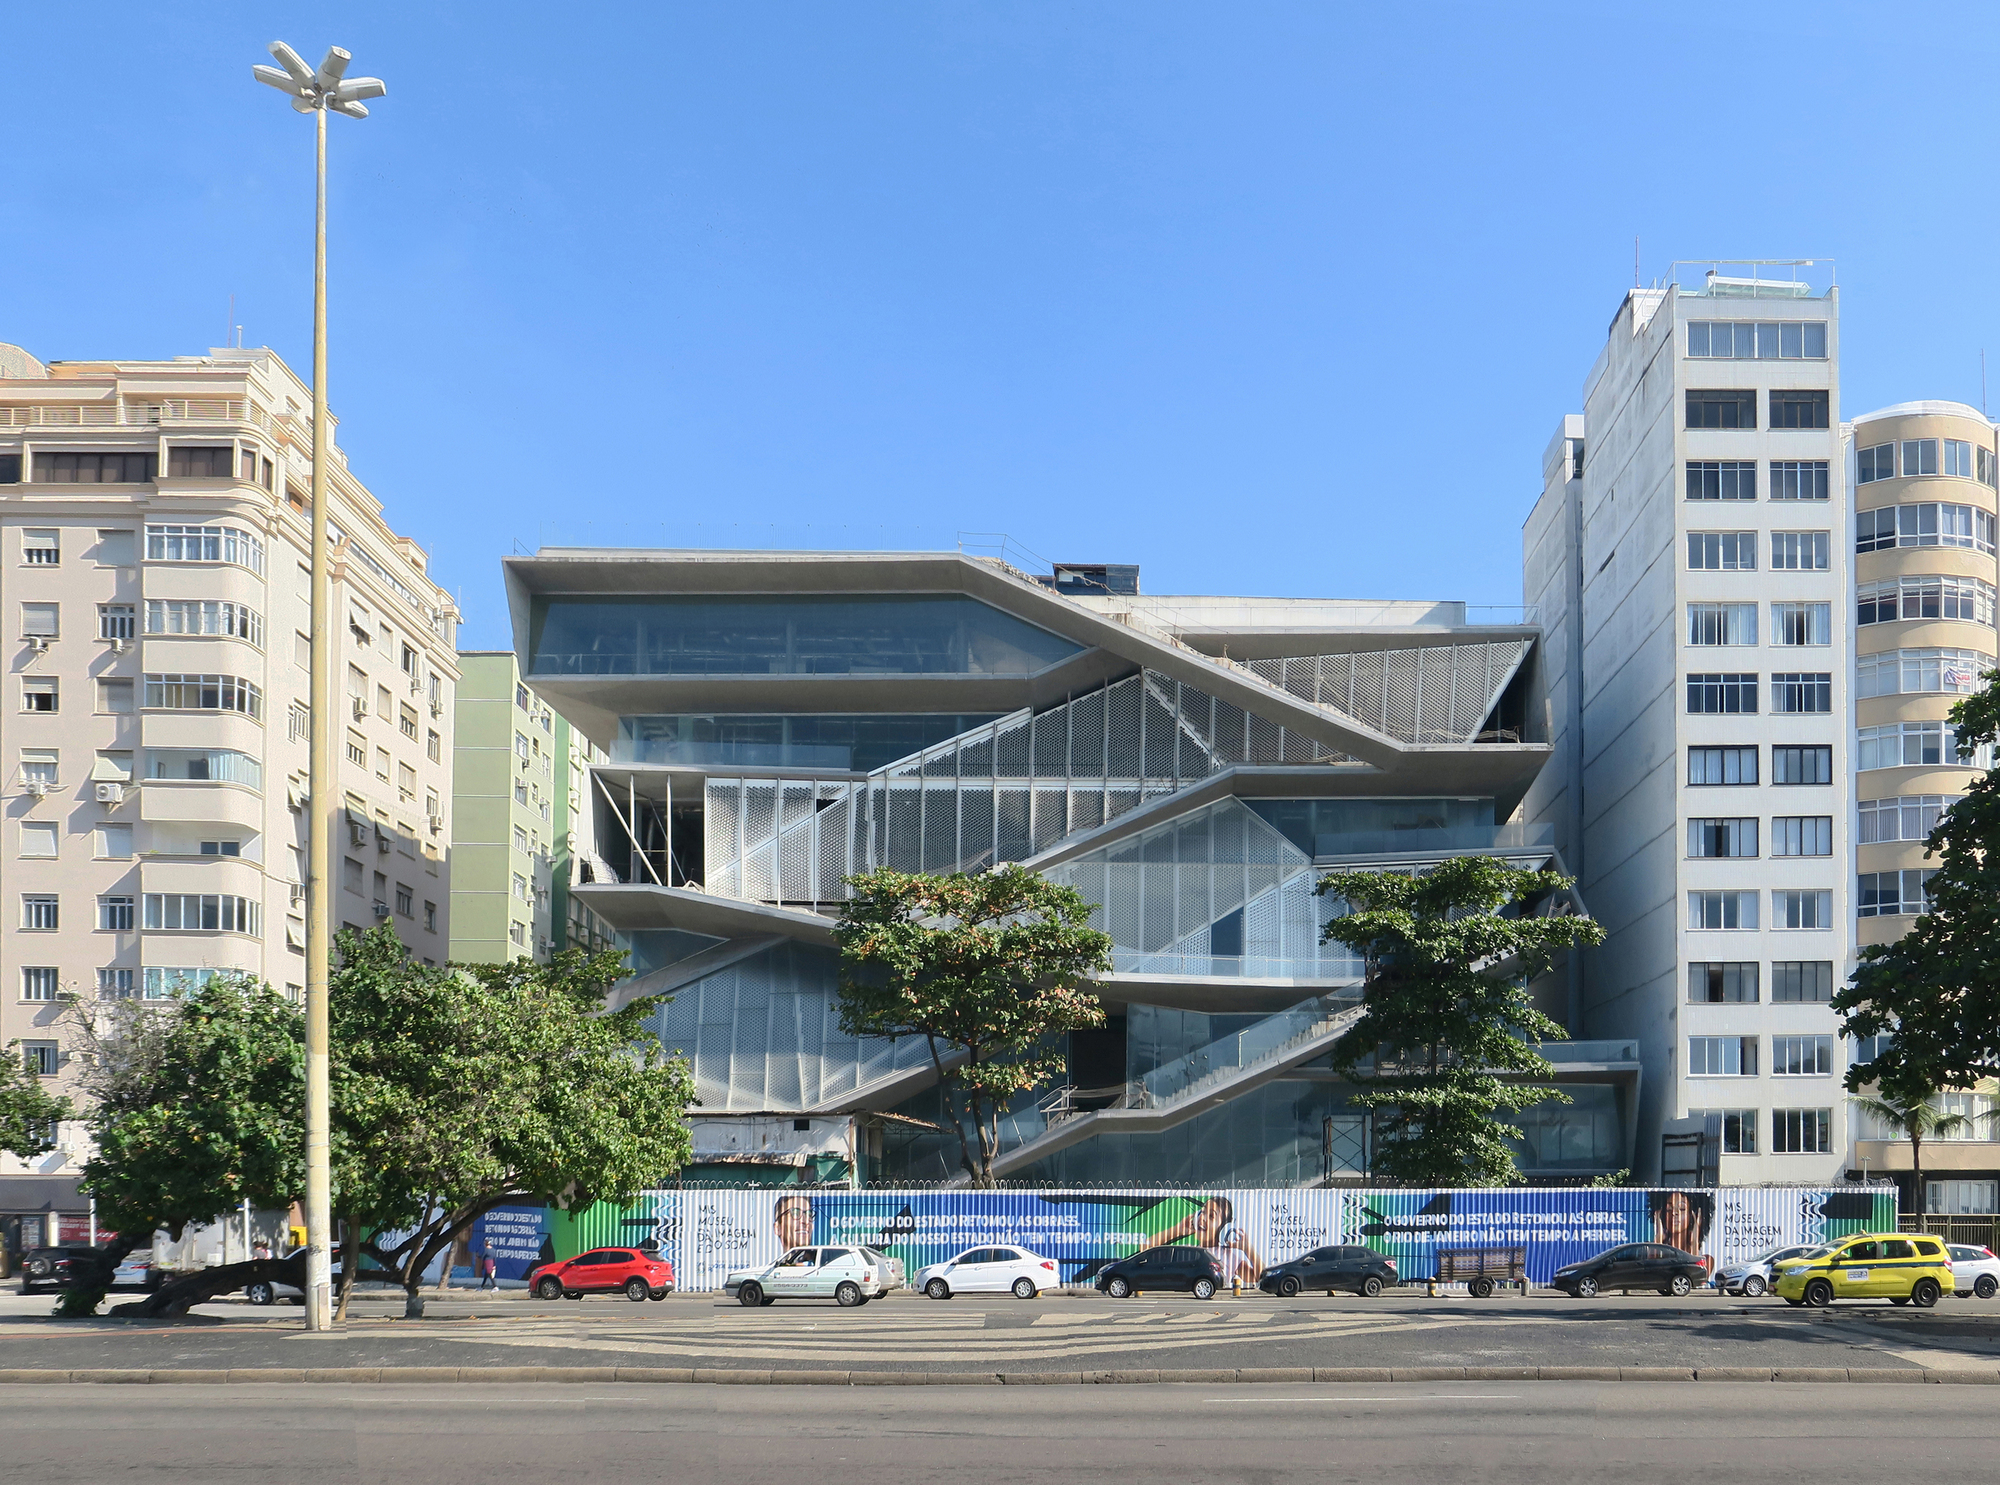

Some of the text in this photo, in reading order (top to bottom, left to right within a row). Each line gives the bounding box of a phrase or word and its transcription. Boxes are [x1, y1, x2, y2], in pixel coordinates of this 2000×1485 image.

[699, 1205, 716, 1214] MIS
[1271, 1204, 1288, 1214] MIS
[1725, 1202, 1742, 1212] MIS
[699, 1216, 734, 1226] MUSEU
[830, 1216, 839, 1228] O
[841, 1216, 895, 1228] GOVERNO
[896, 1216, 913, 1228] DO
[914, 1215, 957, 1228] ESTADO
[960, 1215, 1015, 1228] RETOMOU
[1016, 1215, 1032, 1227] AS
[1271, 1216, 1306, 1225] MUSEU
[1384, 1211, 1627, 1226] O GOVERNO DO ESTADO RETOMOU AS OBRAS.
[1725, 1213, 1760, 1223] MUSEU
[715, 1228, 756, 1239] IMAGEM
[1271, 1228, 1327, 1237] DA IMAGEM
[1383, 1226, 1628, 1243] O RIO DE JANEIRO NÃO TEM TEMPO A PERDER.
[1725, 1226, 1782, 1236] DA IMAGEM
[830, 1233, 839, 1245] A
[840, 1232, 892, 1245] CULTURA
[892, 1233, 909, 1245] DO
[909, 1232, 950, 1245] NOSSO
[951, 1232, 994, 1244] ESTADO
[996, 1229, 1020, 1244] NÃO
[1021, 1232, 1046, 1244] TEM
[1093, 1233, 1102, 1244] A
[1104, 1232, 1150, 1245] PERDER.
[1725, 1237, 1774, 1247] E DO SOM
[697, 1240, 748, 1253] E DO SOM
[1271, 1239, 1320, 1249] E DO SOM
